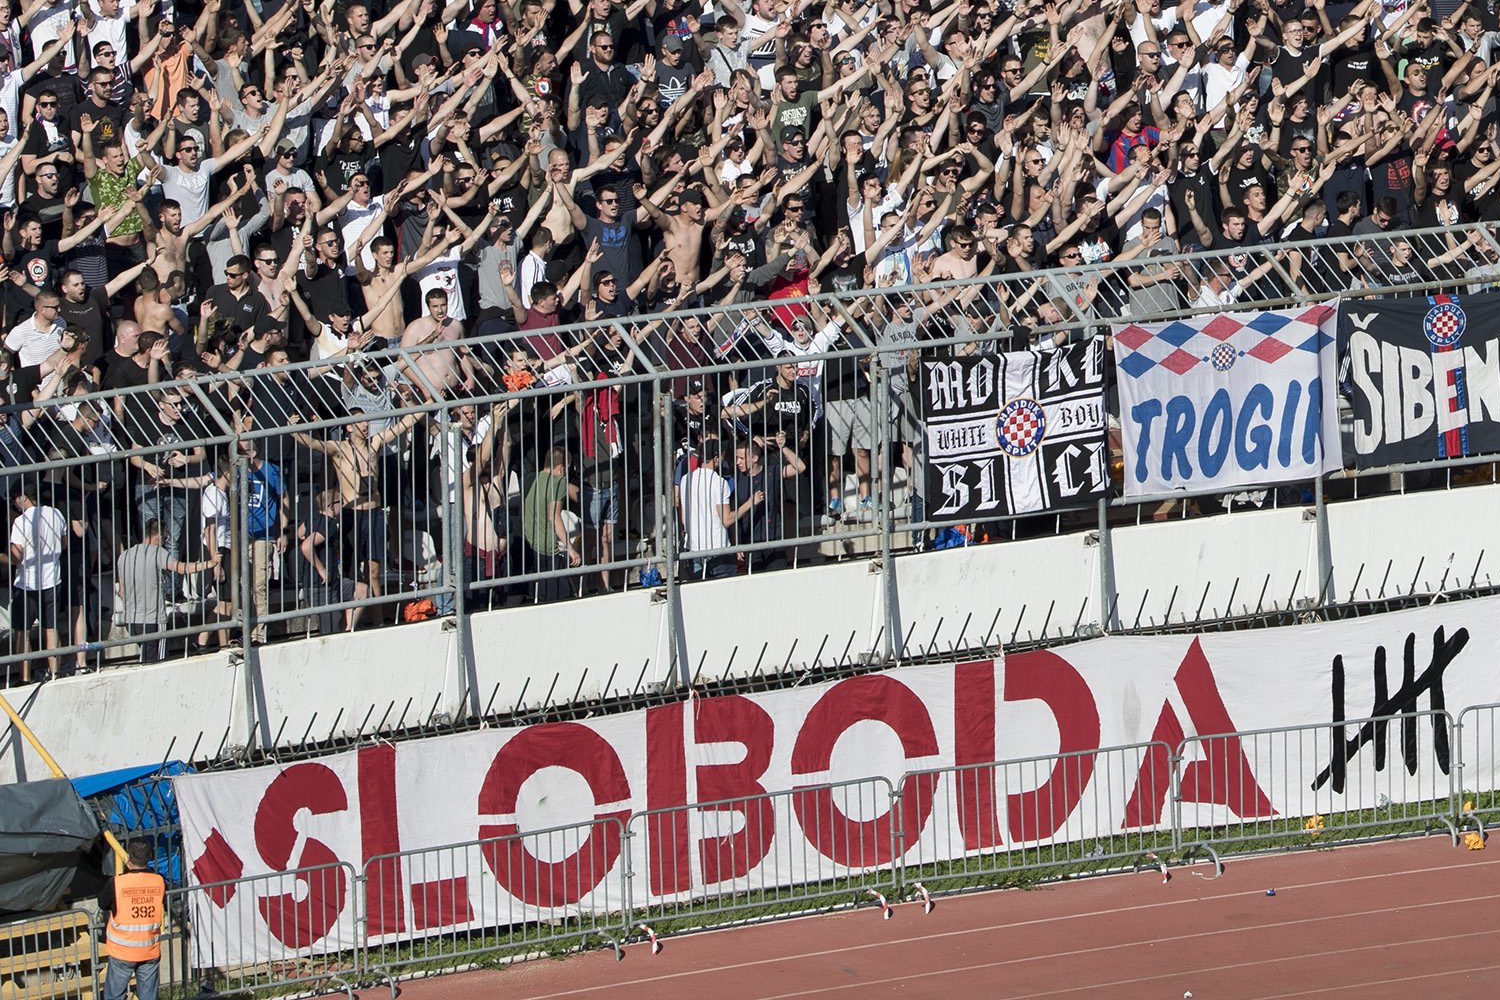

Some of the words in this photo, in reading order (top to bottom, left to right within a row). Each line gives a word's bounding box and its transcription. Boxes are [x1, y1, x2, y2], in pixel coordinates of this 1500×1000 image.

[1425, 302, 1465, 322] HAJDUK
[1430, 329, 1459, 345] SPLIT
[1000, 398, 1043, 422] HAJDUK
[936, 423, 987, 451] WHITE
[1004, 442, 1038, 457] SPLIT
[253, 636, 1280, 949] SLOBODA
[131, 905, 156, 918] 392
